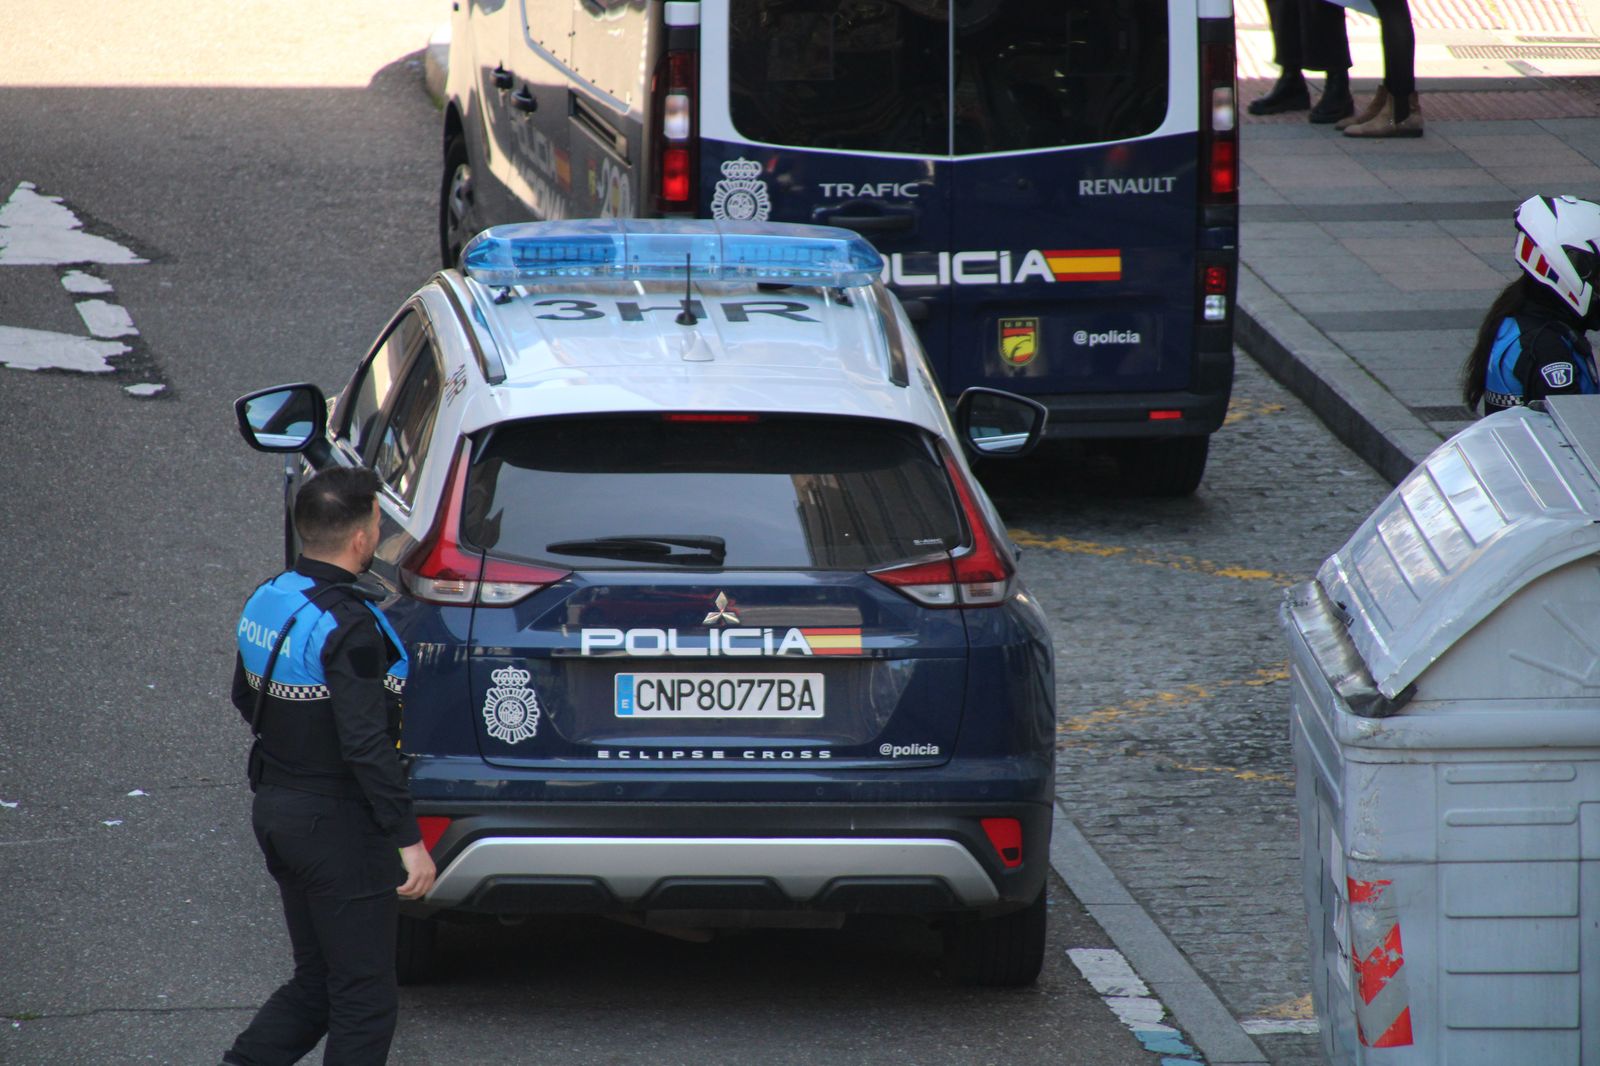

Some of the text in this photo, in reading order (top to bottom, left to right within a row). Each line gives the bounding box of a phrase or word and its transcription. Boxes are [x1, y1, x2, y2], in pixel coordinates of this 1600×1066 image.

[818, 182, 920, 198] TRAFIC
[1078, 176, 1176, 196] RENAULT
[880, 249, 1056, 286] LICIA
[1072, 329, 1141, 347] @policia
[237, 616, 291, 659] POLICA
[635, 678, 816, 712] CNP8077BA
[597, 750, 832, 760] ECLIPSE CROSS
[879, 742, 940, 759] @policia
